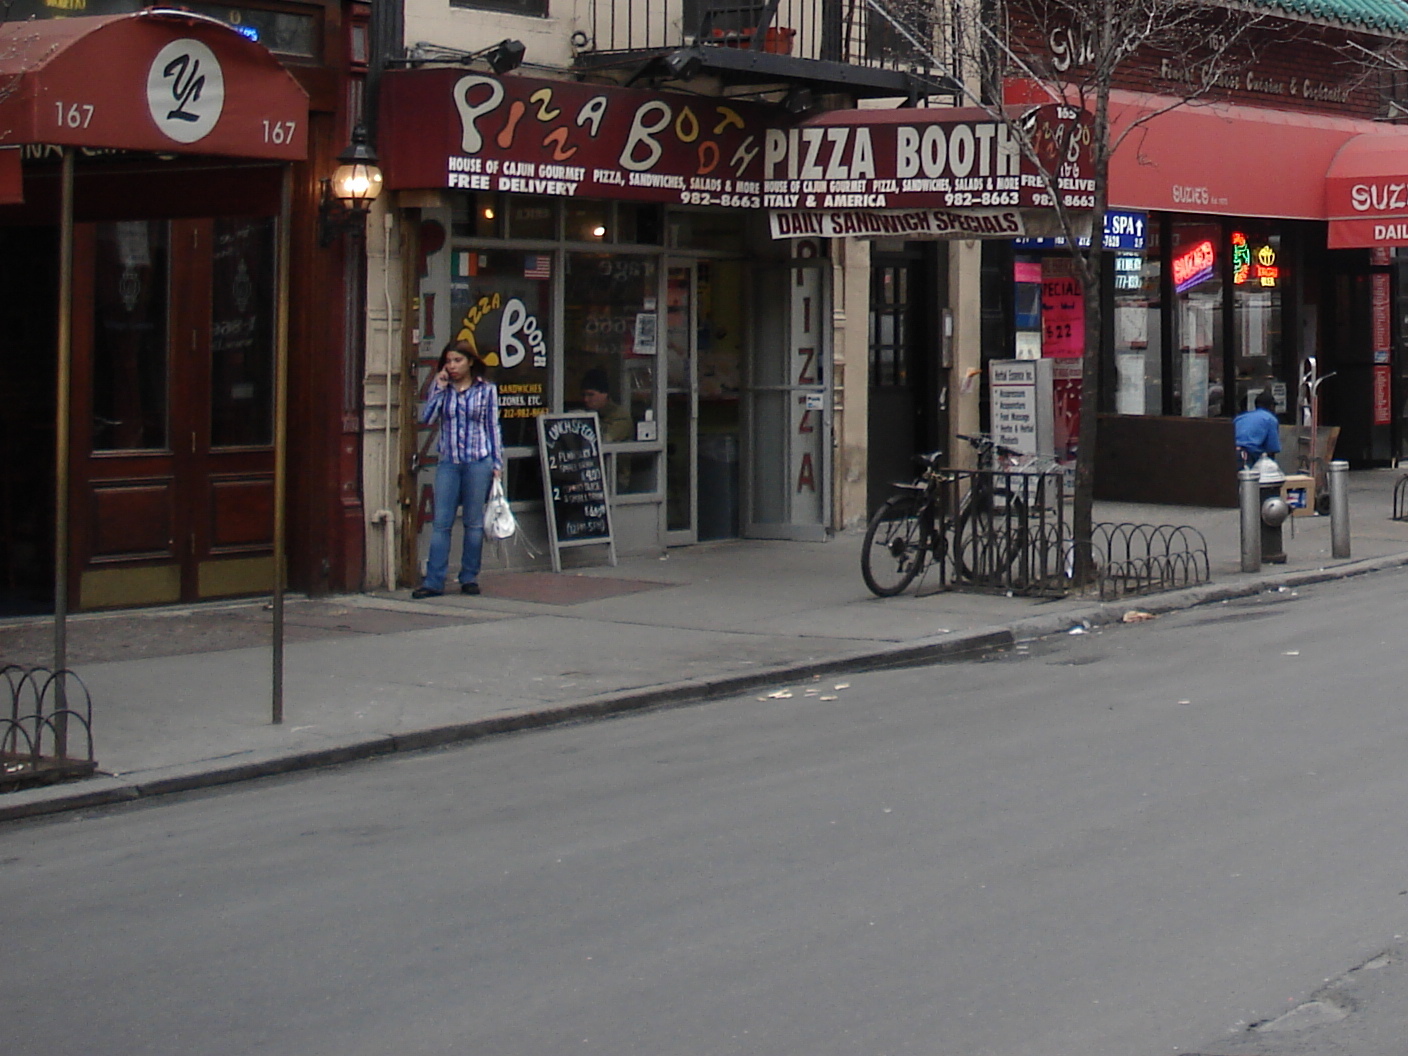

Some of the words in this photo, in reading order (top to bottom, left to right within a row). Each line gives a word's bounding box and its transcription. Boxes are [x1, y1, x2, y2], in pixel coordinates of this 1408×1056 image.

[55, 101, 95, 129] 167
[453, 74, 608, 161] PIZZA
[262, 120, 296, 145] 167
[619, 100, 760, 178] BOOTH
[764, 126, 876, 180] PIZZA
[895, 122, 1021, 179] BOOTH
[448, 173, 490, 191] FREE
[498, 176, 578, 197] DELIVERY
[449, 156, 482, 174] HOUSE
[486, 159, 499, 175] OF
[503, 161, 535, 177] CAJUN
[538, 163, 586, 182] GOURMET
[593, 168, 625, 187] PIZZA,
[628, 172, 687, 191] SANDWICHES,
[689, 176, 722, 193] SALADS
[725, 179, 732, 193] &
[735, 180, 761, 195] MORE
[764, 179, 789, 194] HOUSE
[791, 179, 801, 193] OF
[802, 179, 828, 193] CAJUN
[829, 179, 867, 193] GOURMET
[872, 178, 900, 194] PIZZA,
[954, 176, 984, 192] SALADS
[986, 176, 994, 191] &
[996, 176, 1020, 191] MORE
[680, 191, 761, 209] 982-8663
[763, 194, 799, 209] ITALY
[805, 194, 817, 208] &
[823, 193, 887, 208] AMERICA
[944, 191, 1019, 207] 982-8663
[778, 212, 824, 236] DAILY
[831, 210, 931, 236] SANDWICH
[934, 210, 1020, 235] SPECIALS
[1112, 215, 1135, 234] SPA
[500, 297, 547, 369] BOOTH
